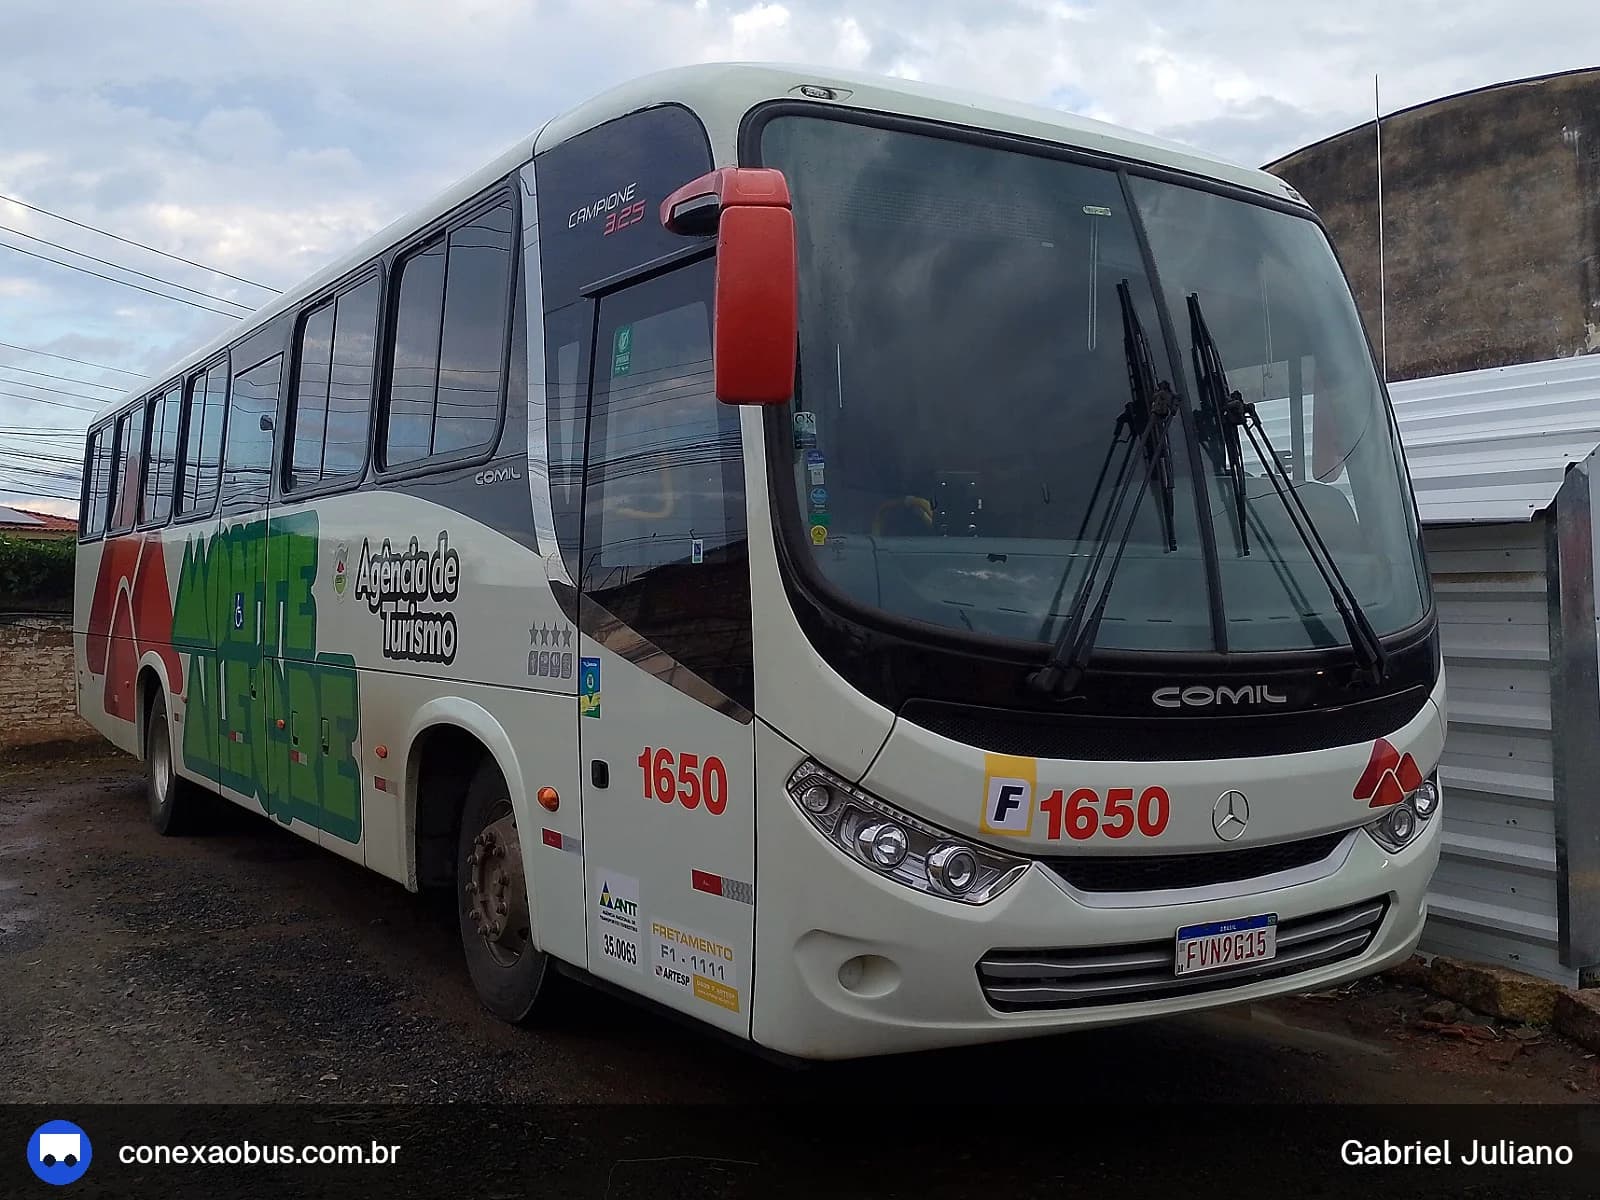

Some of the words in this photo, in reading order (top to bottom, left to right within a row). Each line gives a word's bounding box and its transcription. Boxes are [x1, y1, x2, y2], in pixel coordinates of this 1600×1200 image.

[568, 182, 637, 229] CAMPIONE
[603, 199, 647, 236] 3.25
[475, 466, 521, 485] COMIL
[172, 510, 319, 652] MONTE
[354, 535, 429, 614] Agência
[430, 530, 461, 602] de
[379, 600, 457, 665] Turismo
[1152, 685, 1287, 708] COMIL
[182, 652, 363, 845] ALEGRE
[637, 746, 729, 816] 1650
[994, 785, 1023, 822] F
[1040, 786, 1170, 840] 1650
[613, 897, 638, 917] ANTT
[603, 933, 637, 966] 35.0063
[652, 922, 733, 962] FRETAMENTO
[1186, 930, 1267, 969] FVN9G15
[661, 944, 676, 962] F1
[691, 955, 725, 981] 1111
[663, 968, 690, 987] ARTESP
